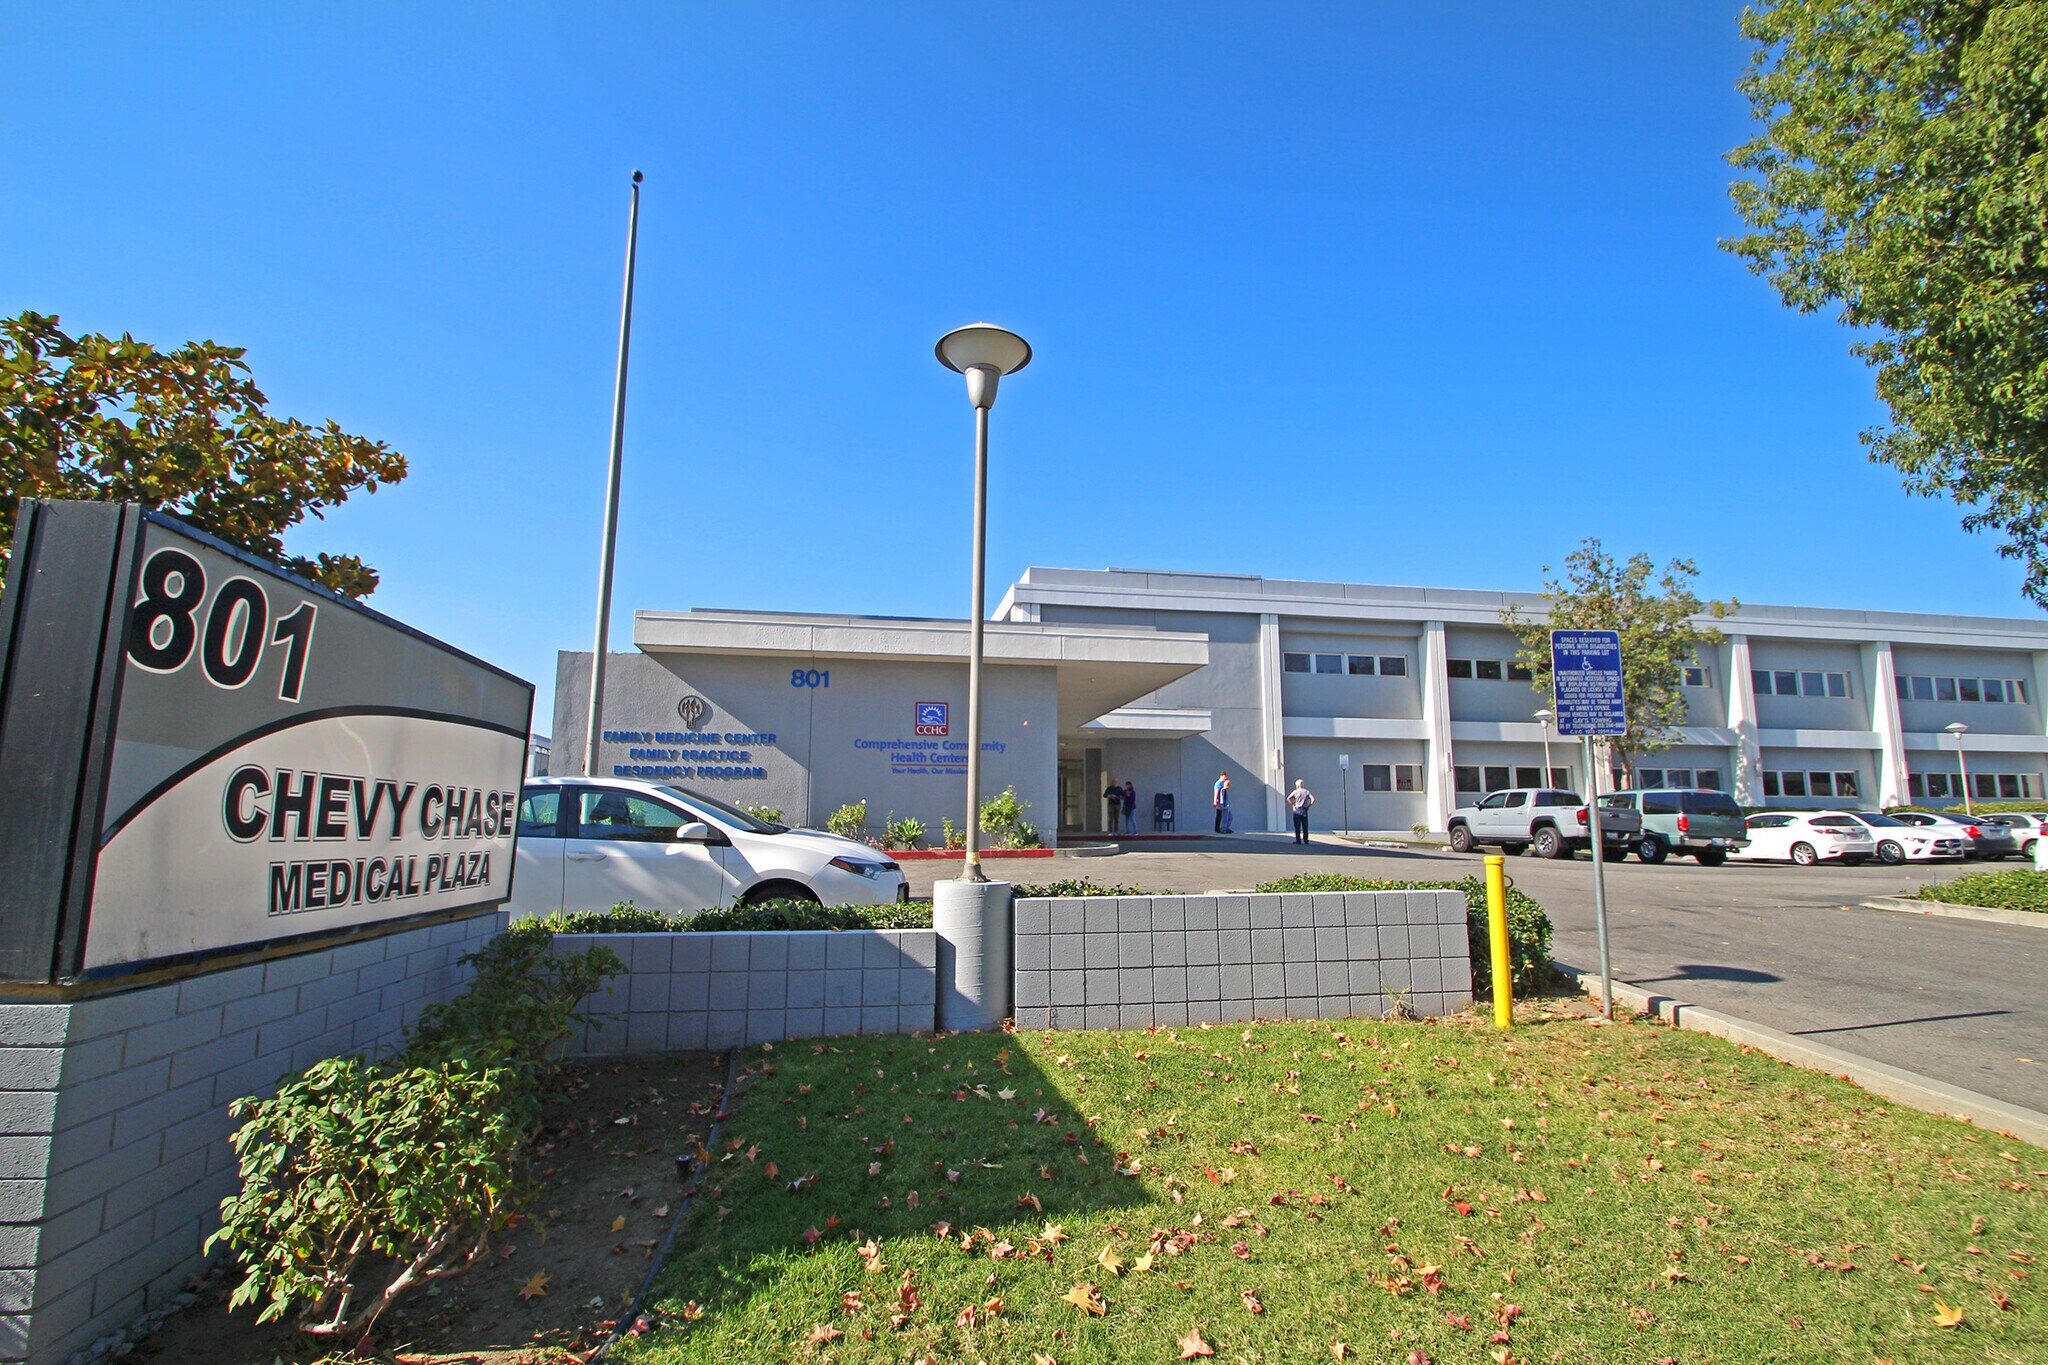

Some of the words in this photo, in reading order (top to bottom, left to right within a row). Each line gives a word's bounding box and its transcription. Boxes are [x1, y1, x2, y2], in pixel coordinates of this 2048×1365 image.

[127, 546, 318, 703] 801
[790, 669, 830, 688] 801
[916, 725, 947, 735] CCHC
[603, 731, 650, 742] FAMILY
[655, 732, 722, 743] MEDICINE
[724, 733, 777, 744] CENTER
[854, 738, 939, 752] Comprehensive
[629, 748, 676, 759] FAMILY
[682, 749, 750, 761] PRACTICE
[891, 751, 927, 763] Health
[614, 765, 691, 777] RESIDENCY
[697, 766, 764, 777] PROGRAM
[222, 764, 418, 843] CHEVY
[419, 783, 516, 840] CHASE
[267, 854, 421, 917] MEDICAL
[423, 850, 491, 896] PLAZA
